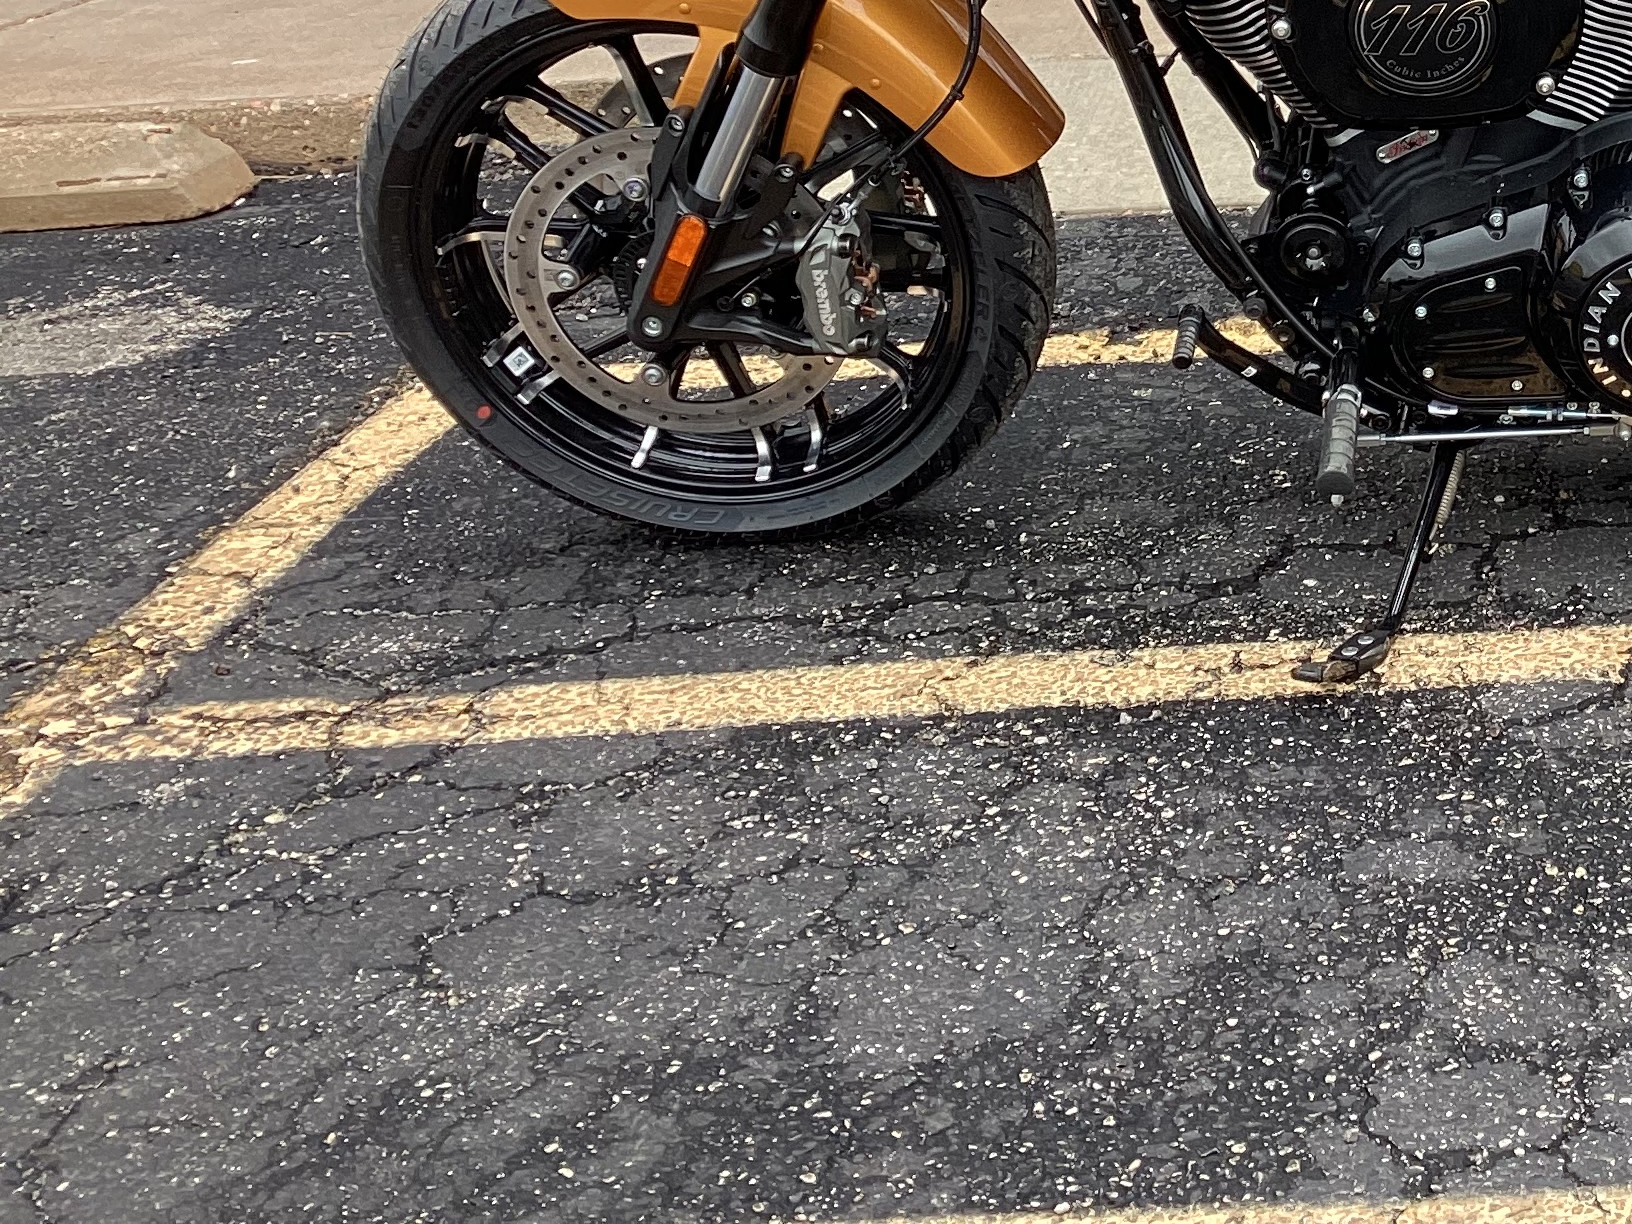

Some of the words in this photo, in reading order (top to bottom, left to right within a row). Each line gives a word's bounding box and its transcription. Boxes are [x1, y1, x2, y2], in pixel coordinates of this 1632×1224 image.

[1364, 0, 1490, 55] 116
[1386, 59, 1422, 79] Cubic
[1426, 55, 1467, 79] Inches
[812, 269, 837, 336] brembo
[1582, 282, 1621, 384] INDIAN
